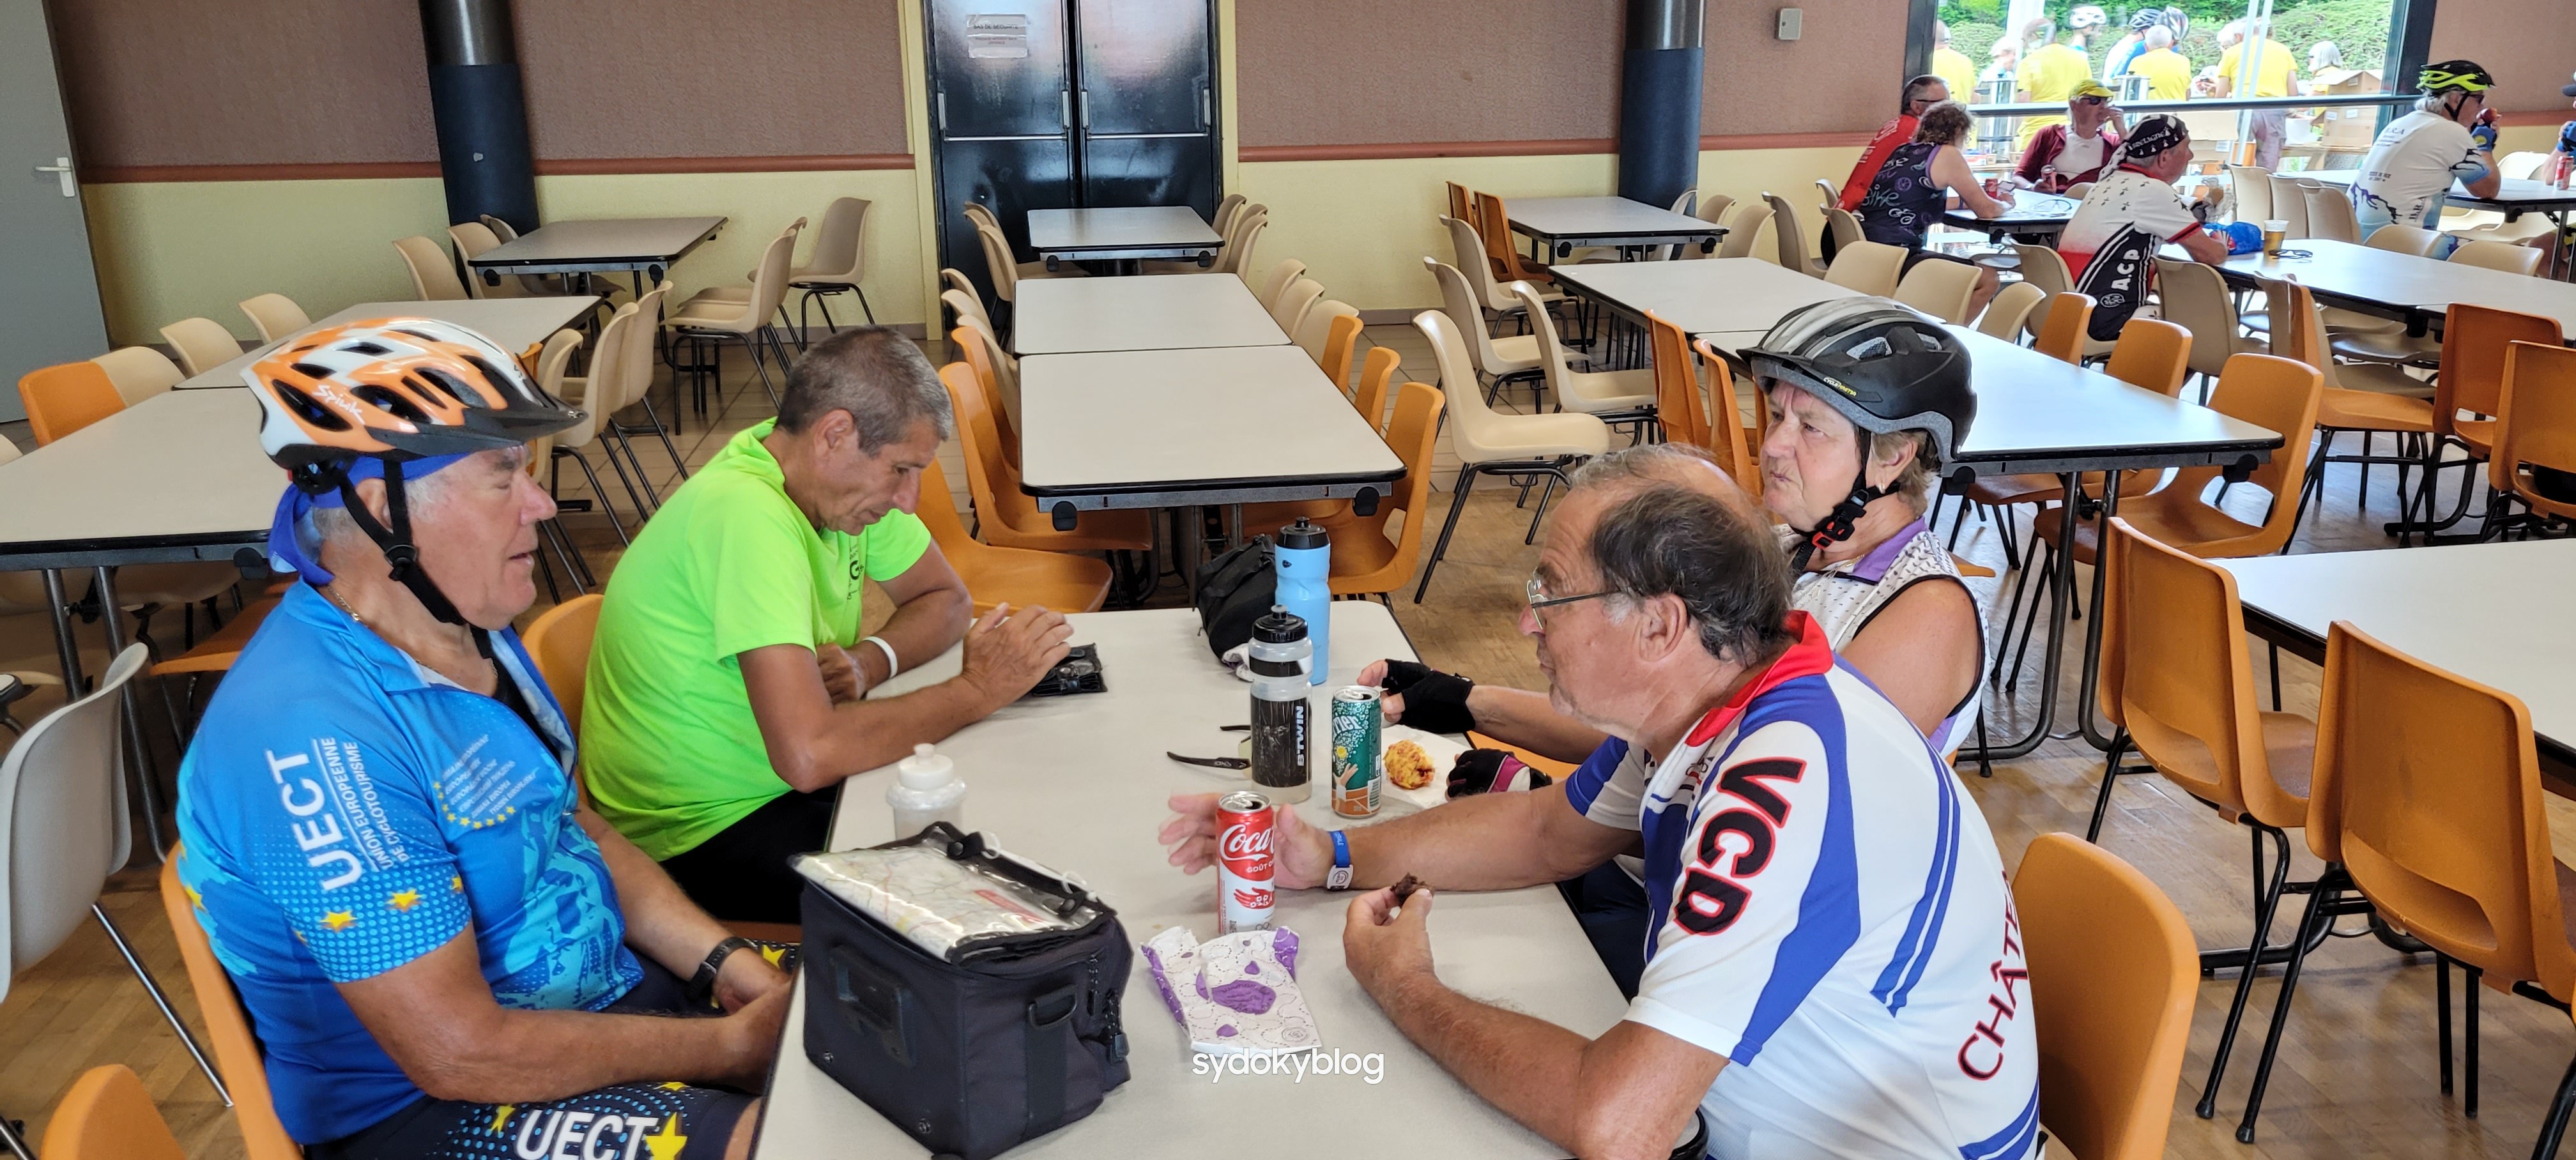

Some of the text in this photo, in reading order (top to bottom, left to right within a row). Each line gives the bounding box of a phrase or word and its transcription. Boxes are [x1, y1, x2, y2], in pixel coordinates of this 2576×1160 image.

[311, 385, 365, 425] Spiuk
[264, 749, 363, 891] UECT
[321, 736, 394, 871] UNION EUROPEENNE
[344, 741, 410, 862] DE CYCLOTOURISME
[1674, 756, 1807, 936] VCD
[1246, 862, 1268, 873] GOÛT
[1958, 870, 2028, 1081] CHÂTE
[516, 1109, 661, 1160] UECT
